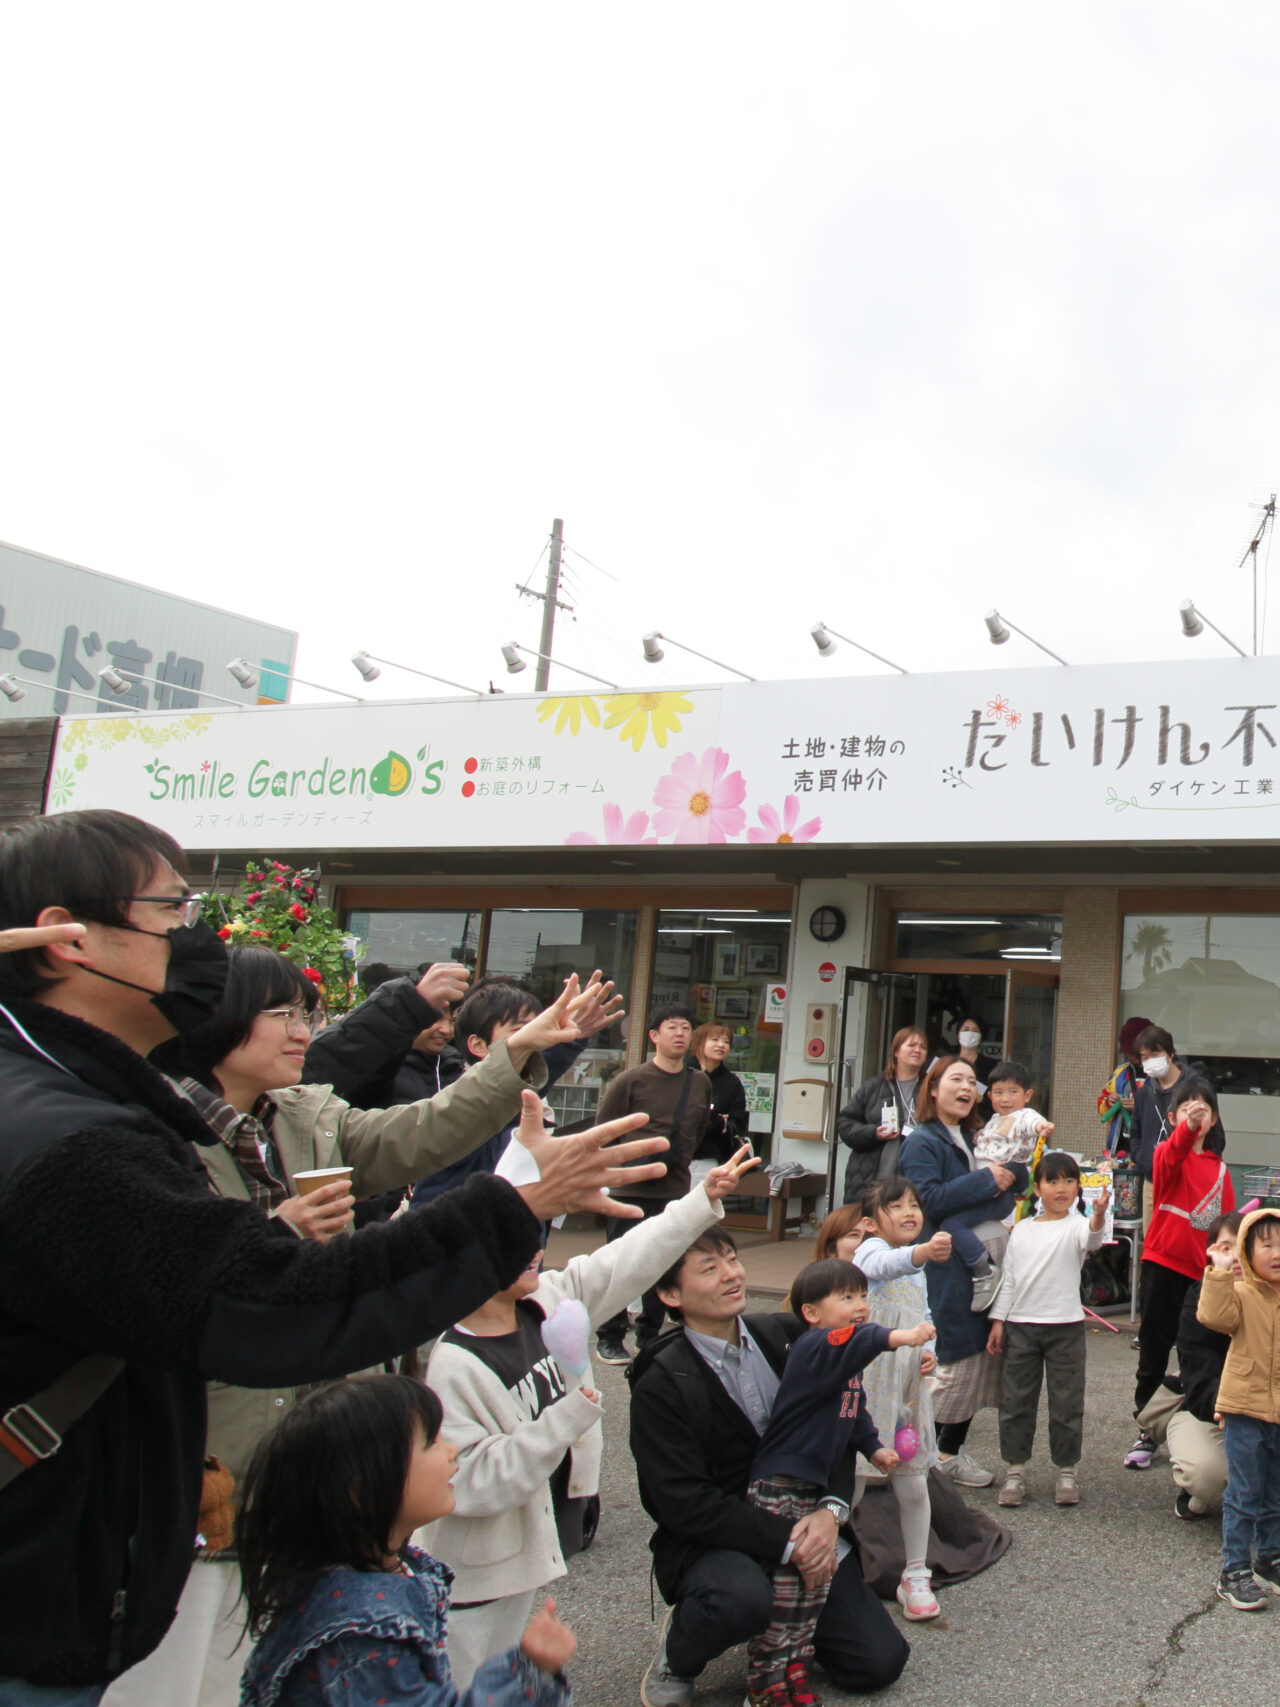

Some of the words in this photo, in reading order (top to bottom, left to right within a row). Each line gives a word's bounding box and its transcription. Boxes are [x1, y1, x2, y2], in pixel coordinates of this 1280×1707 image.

[781, 735, 906, 759] 土地・建物の
[479, 756, 542, 773] 新築外構
[150, 758, 236, 801] Smile
[248, 757, 367, 799] Garden
[476, 779, 605, 796] お庭のリフォーム
[794, 768, 888, 792] 売買仲介
[194, 809, 373, 829] スマイルガーデンディーズ
